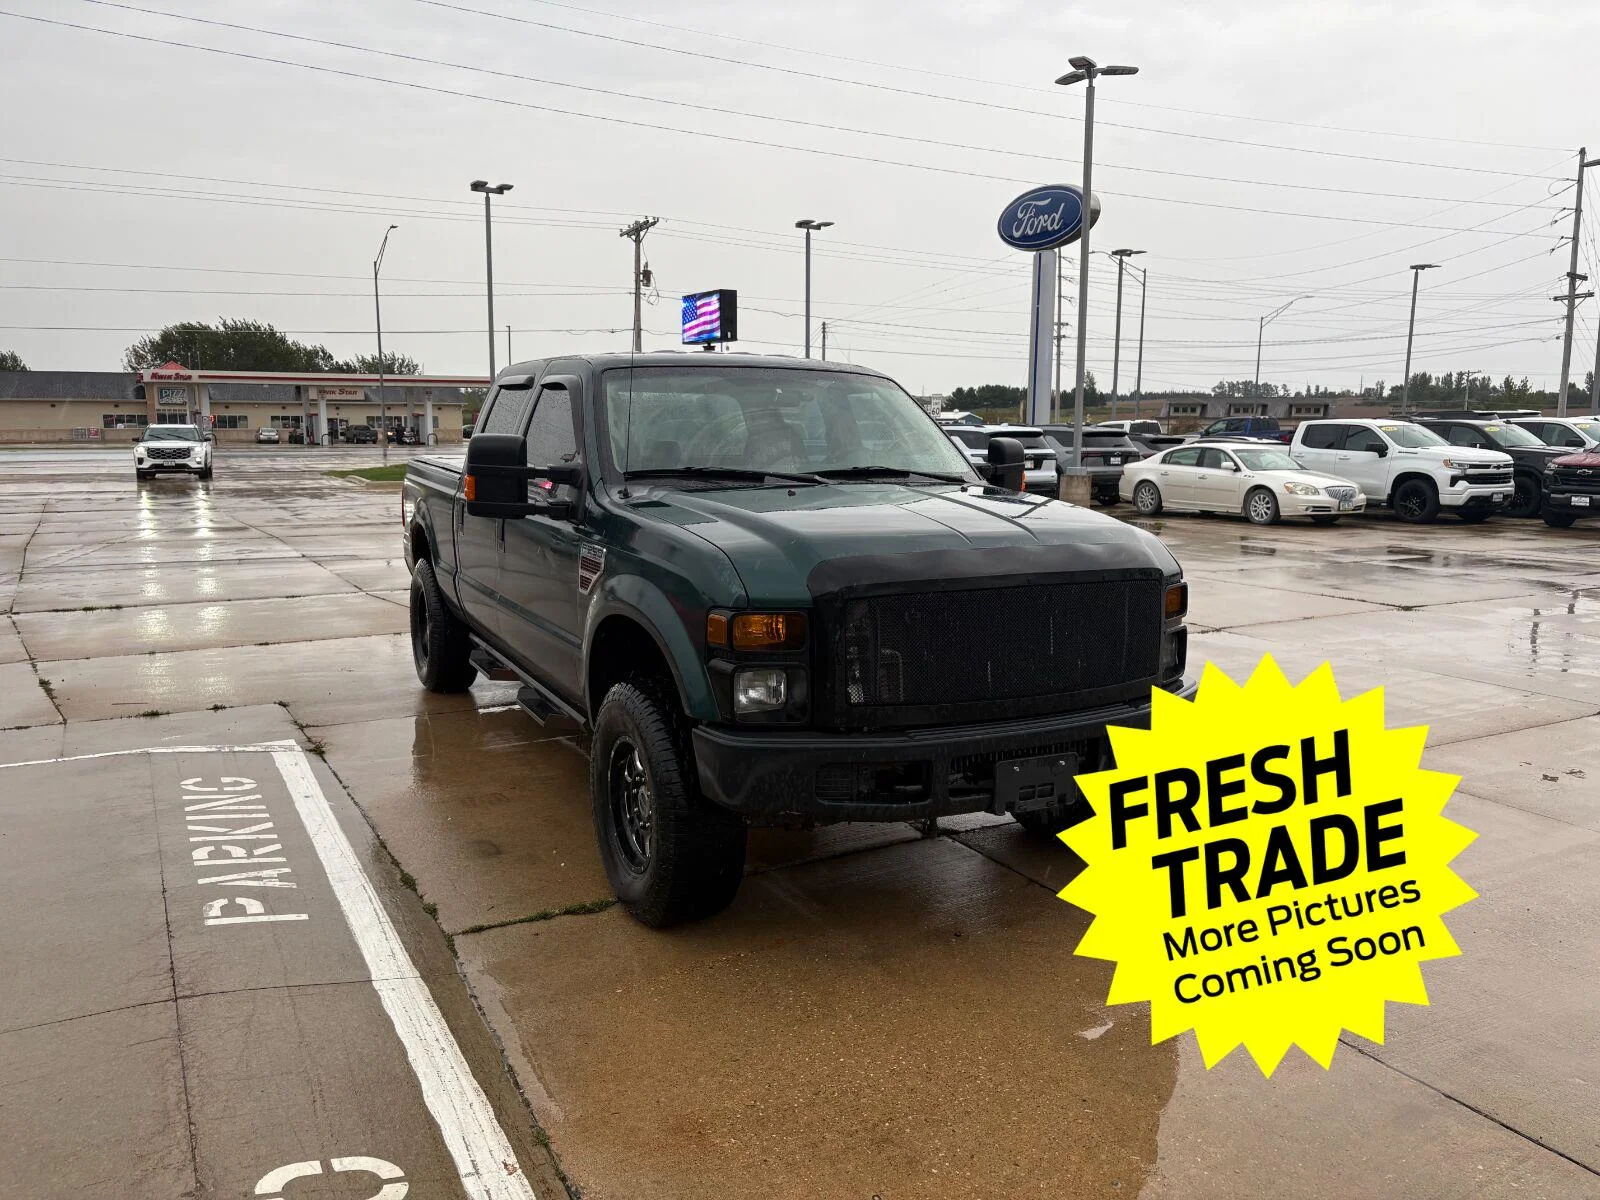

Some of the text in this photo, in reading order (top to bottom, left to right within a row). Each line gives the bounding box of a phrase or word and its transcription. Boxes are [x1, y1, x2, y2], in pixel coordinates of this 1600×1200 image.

[1012, 197, 1065, 238] Ford
[931, 407, 940, 415] 60
[180, 776, 309, 926] PARKING
